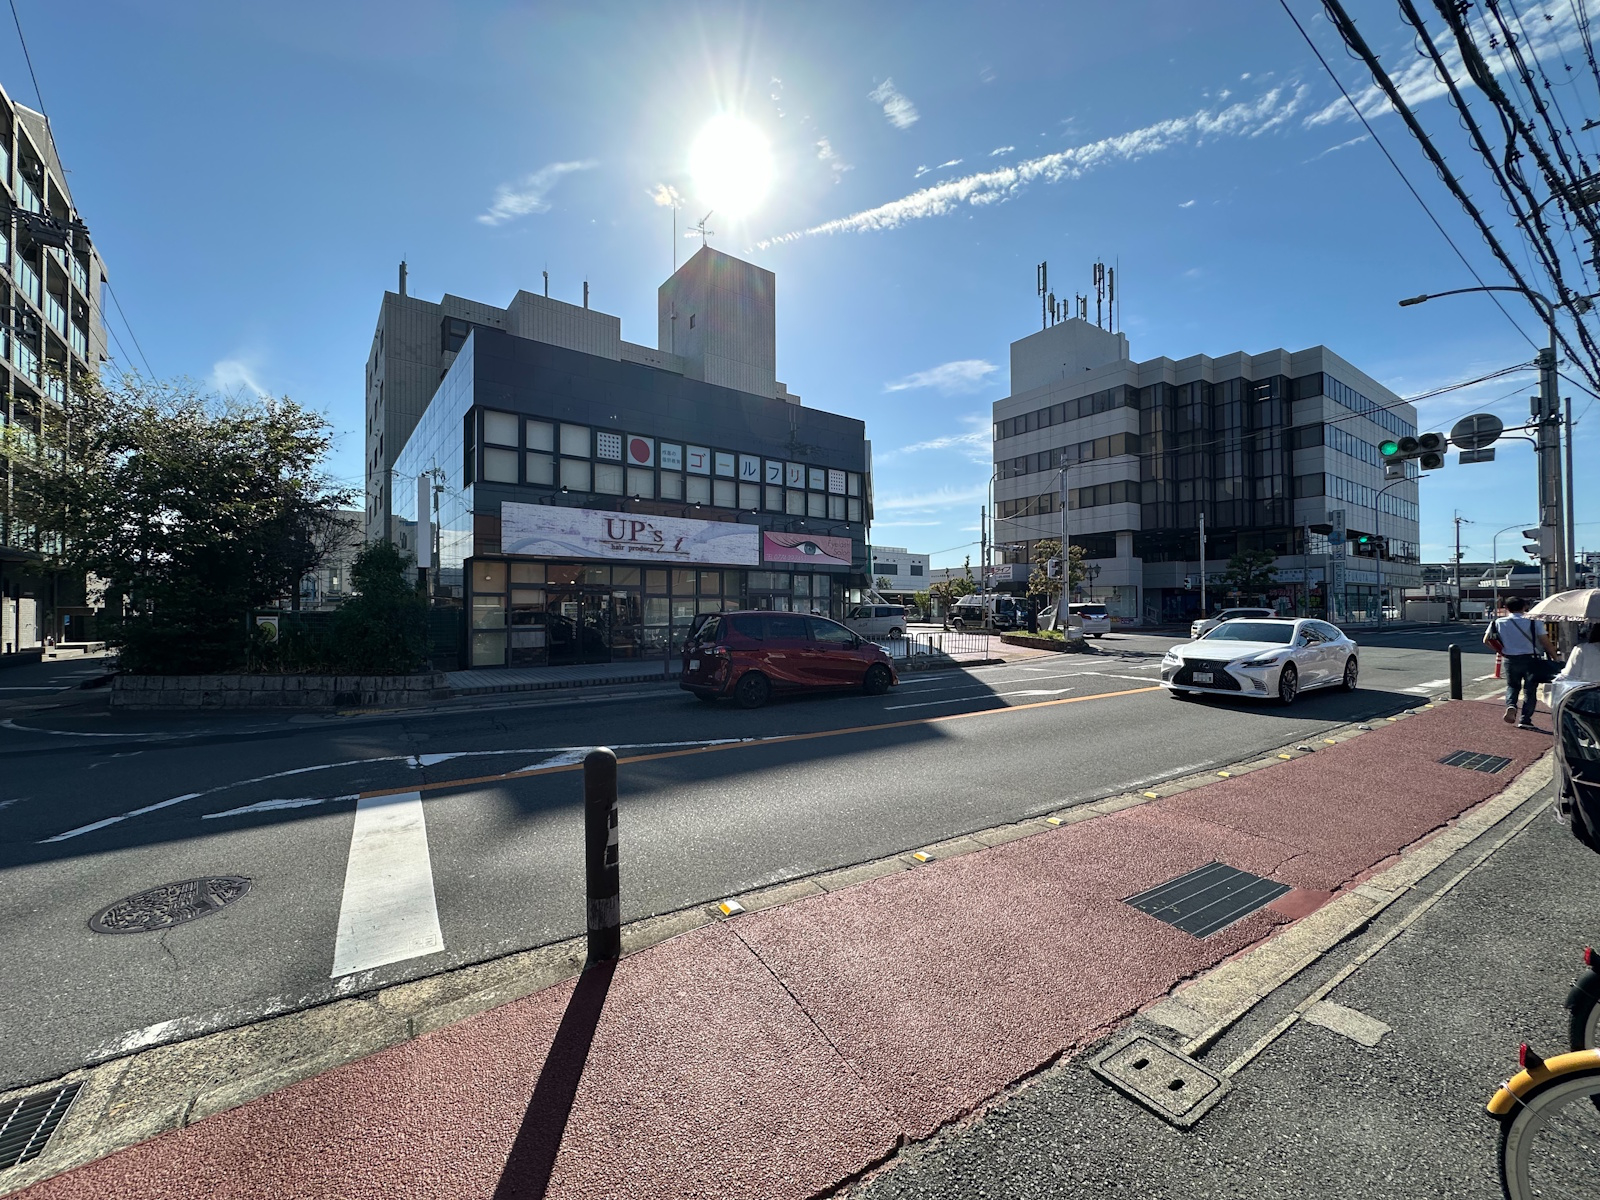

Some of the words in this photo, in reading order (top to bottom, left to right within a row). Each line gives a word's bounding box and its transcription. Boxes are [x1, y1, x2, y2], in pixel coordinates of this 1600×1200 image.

[690, 453, 822, 483] ゴールフリー
[610, 543, 626, 551] hair
